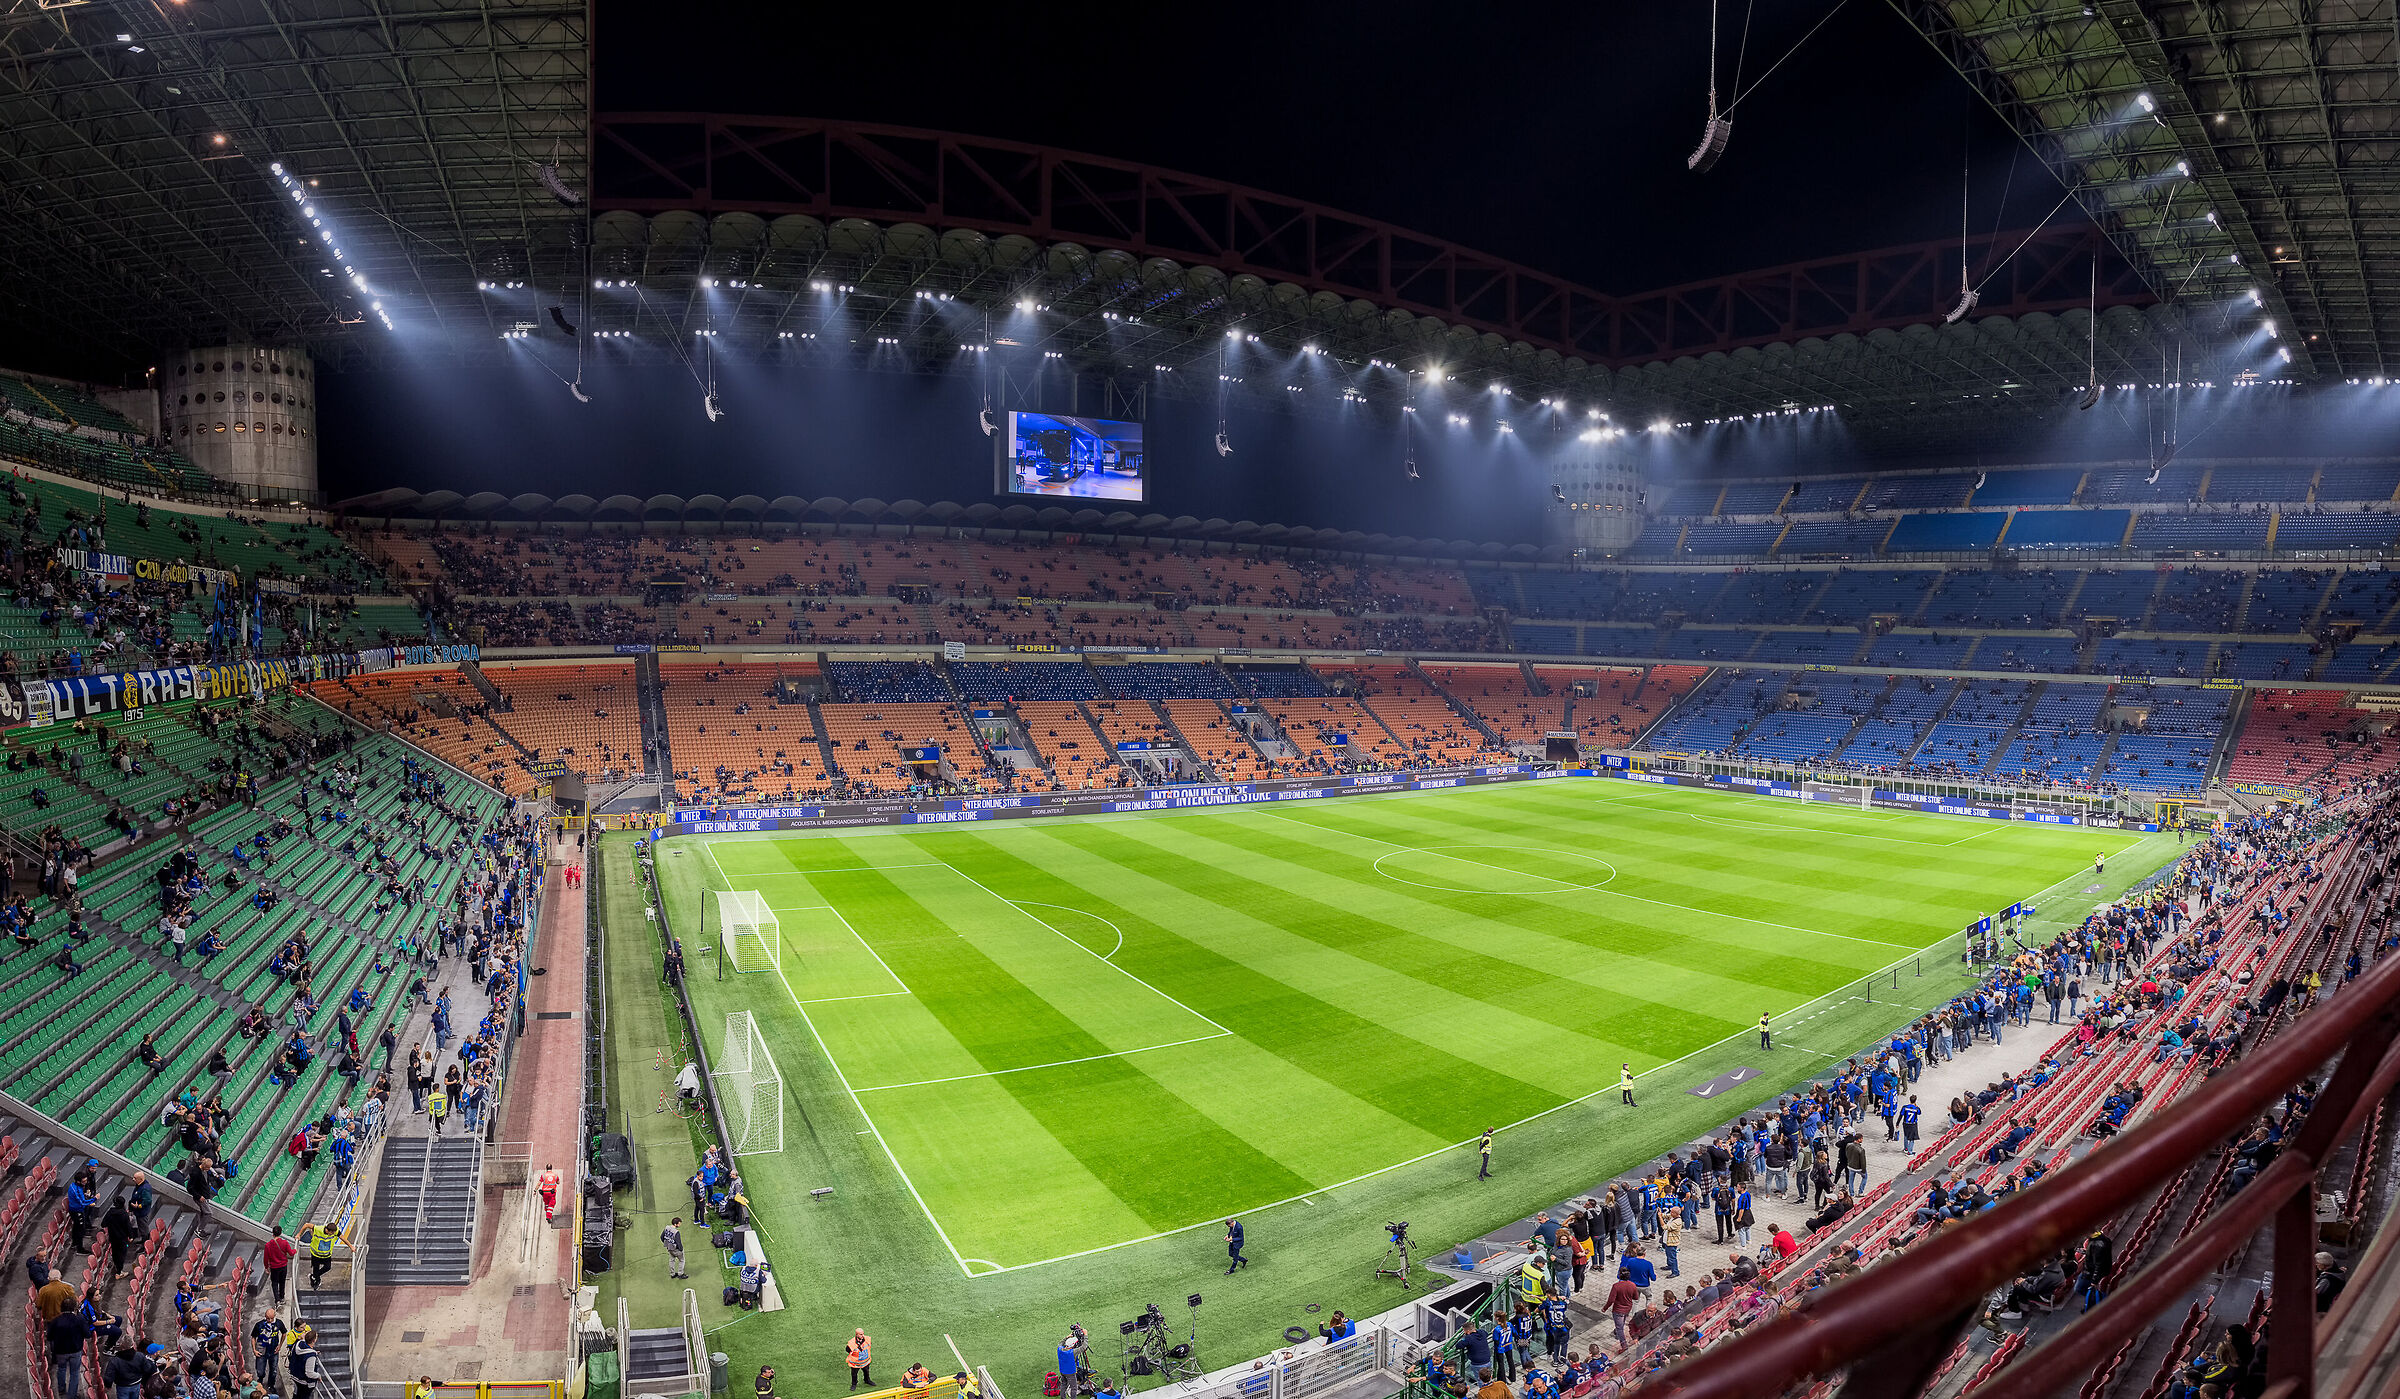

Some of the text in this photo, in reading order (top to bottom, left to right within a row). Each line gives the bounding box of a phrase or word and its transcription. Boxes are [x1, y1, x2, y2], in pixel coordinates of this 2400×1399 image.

[441, 644, 479, 663] ROMA
[208, 663, 248, 698] BOYS
[124, 708, 144, 721] 1975
[1607, 757, 1622, 767] INTER
[1784, 789, 1799, 798] ONLINE
[2234, 782, 2273, 795] POLICORO
[1279, 789, 1322, 800] INTER ONLINE STORE
[1896, 793, 1910, 801] INTER
[1910, 794, 1928, 803] ONLINE
[980, 800, 1003, 808] ONLINE
[1003, 798, 1021, 807] STORE
[1116, 800, 1168, 811] INTER ONLINE STORE
[681, 811, 700, 822] INTER
[738, 808, 802, 820] INTER ONLINE STORE
[1939, 805, 1990, 817] INTER ONLINE STORE
[917, 811, 977, 823] INTER ONLINE STORE
[694, 820, 760, 833] INTER ONLINE STORE
[1908, 1112, 1914, 1122] 7
